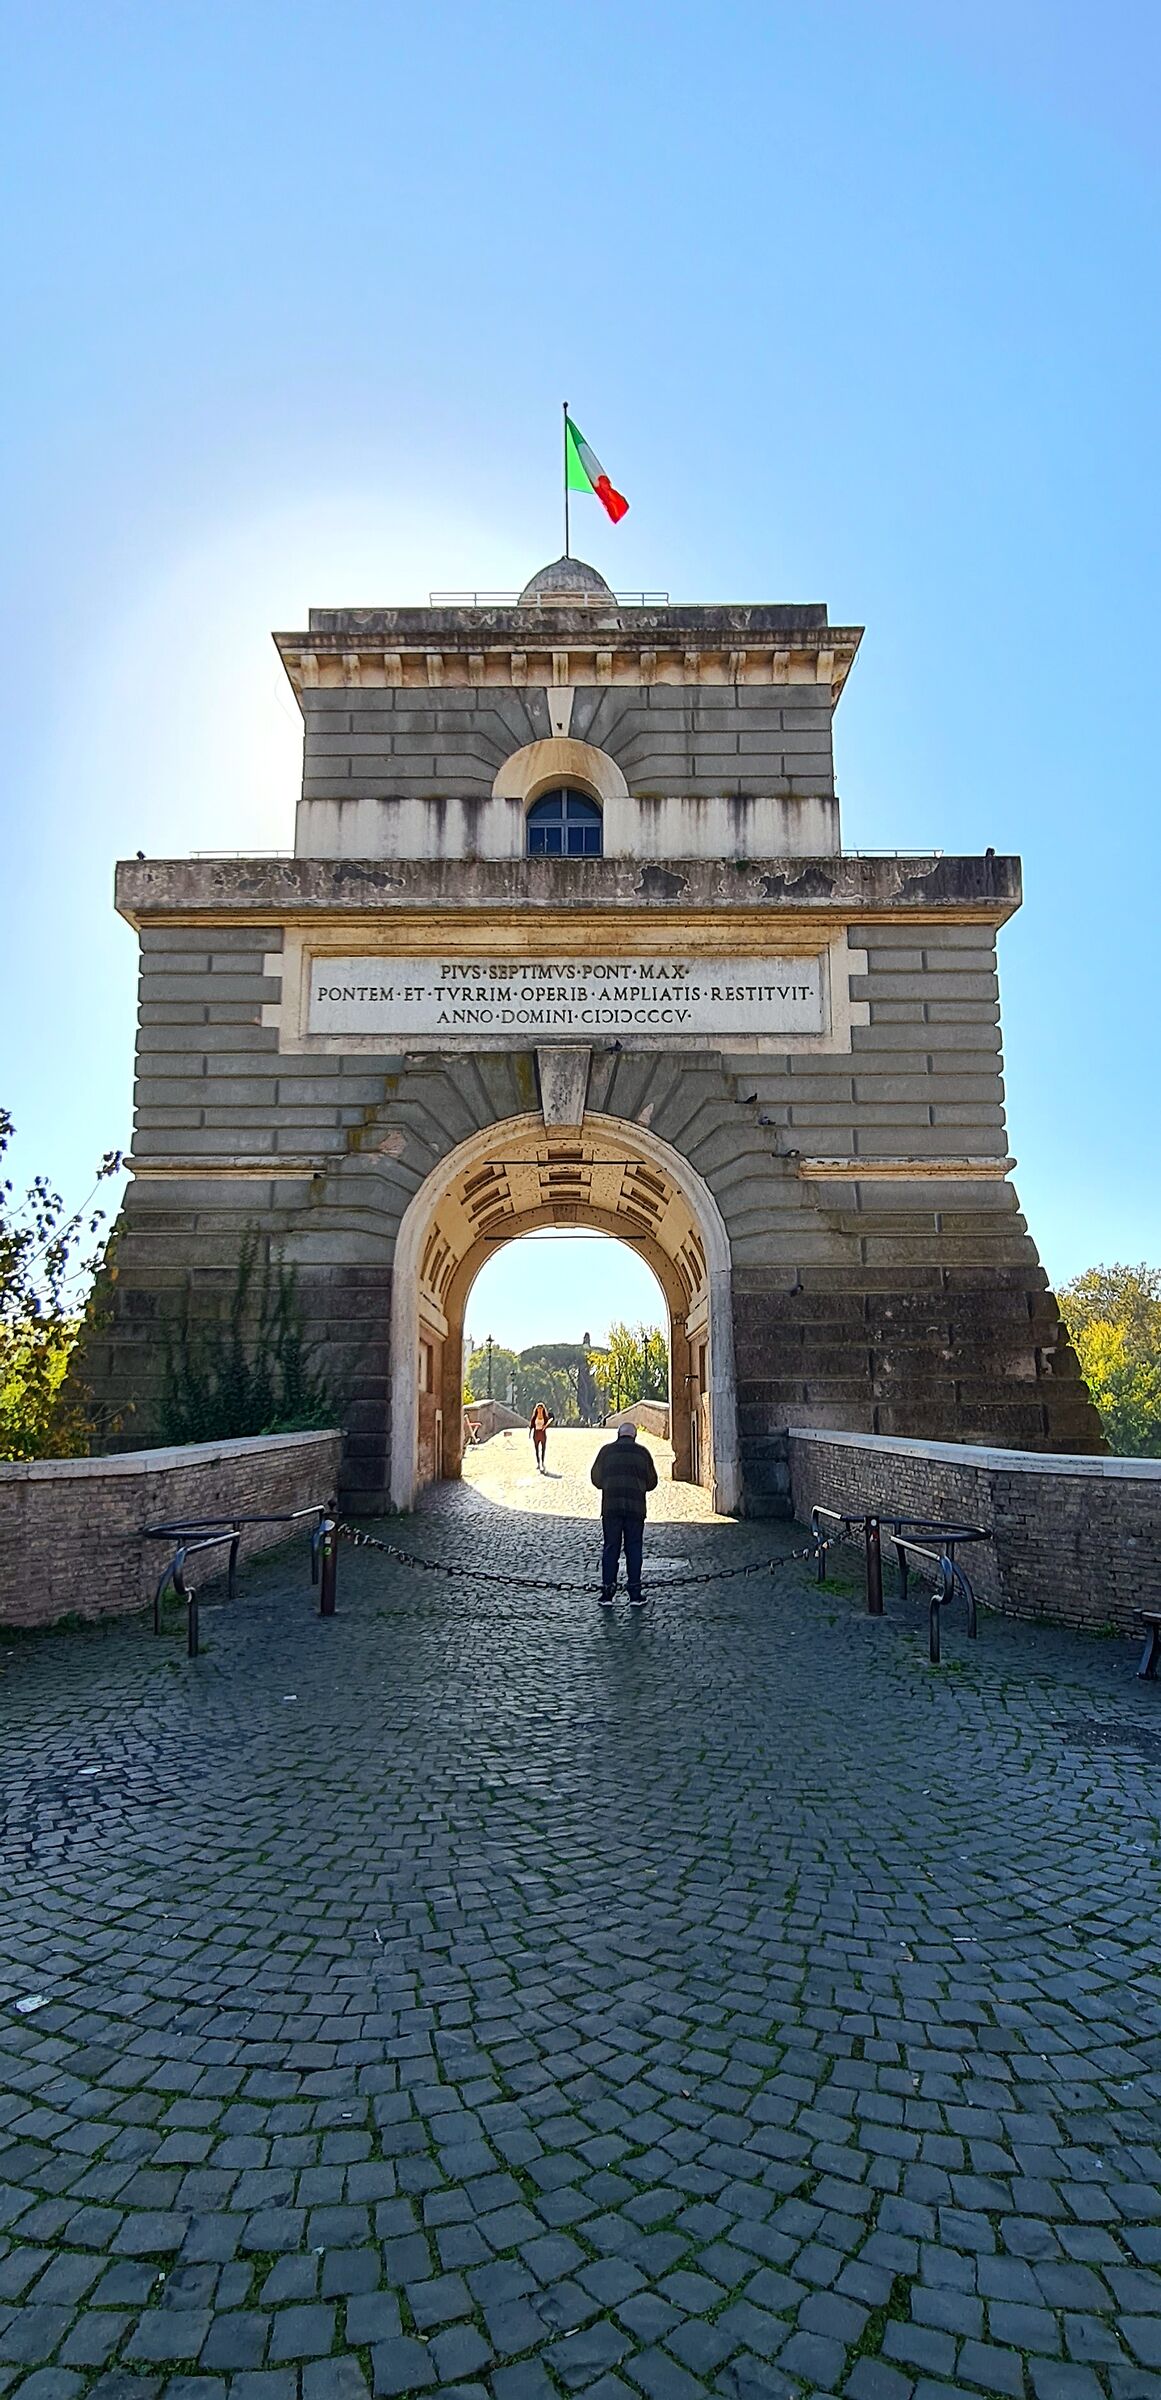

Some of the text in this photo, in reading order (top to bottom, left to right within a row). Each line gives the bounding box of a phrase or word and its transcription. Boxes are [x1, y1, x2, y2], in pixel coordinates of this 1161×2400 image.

[318, 987, 394, 1001] PONTEM
[404, 987, 425, 1001] ET
[520, 987, 588, 1001] OPERIB
[597, 987, 700, 1001] AMPLIATIS
[436, 1010, 493, 1024] ANNO
[501, 1010, 573, 1024] DOMINI
